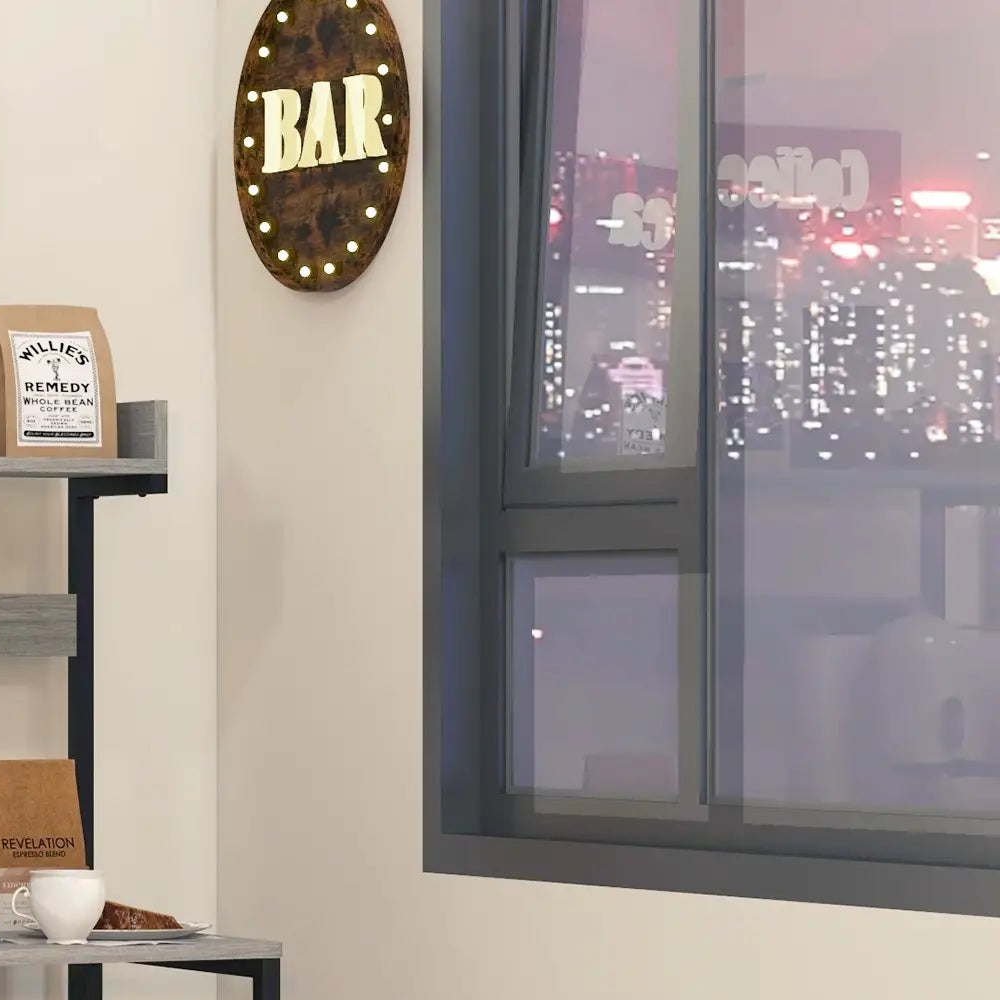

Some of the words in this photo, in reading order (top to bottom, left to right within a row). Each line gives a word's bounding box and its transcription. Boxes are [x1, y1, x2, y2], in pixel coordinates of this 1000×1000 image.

[261, 74, 388, 174] BAR
[19, 341, 89, 365] WILLIE'S
[25, 382, 90, 392] REMEDY
[23, 397, 61, 405] WHOLE
[64, 398, 94, 406] BEAN
[1, 837, 75, 850] REVELATION
[12, 850, 44, 859] ESPRESSO
[45, 850, 66, 858] BLEND
